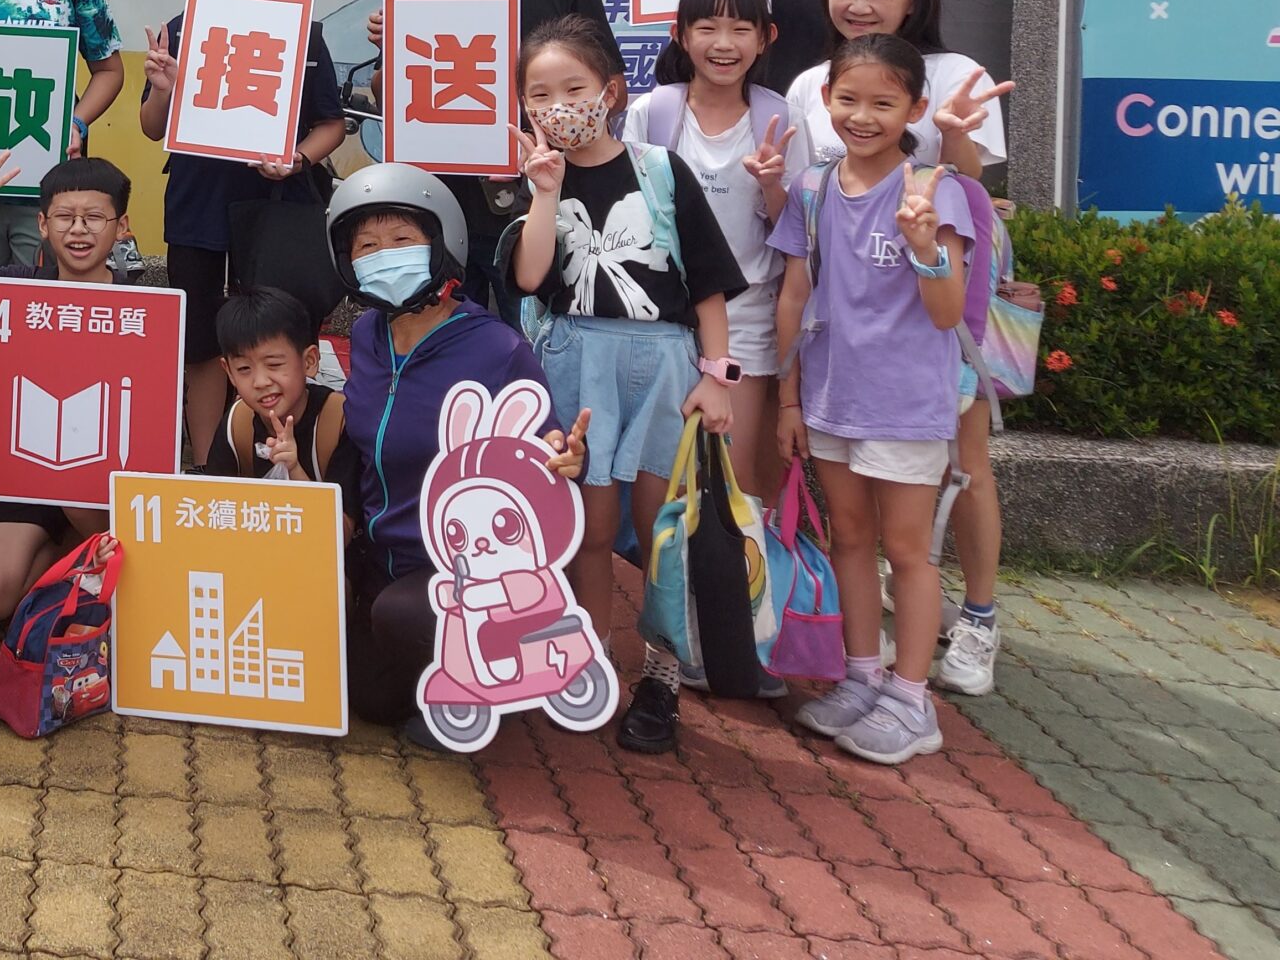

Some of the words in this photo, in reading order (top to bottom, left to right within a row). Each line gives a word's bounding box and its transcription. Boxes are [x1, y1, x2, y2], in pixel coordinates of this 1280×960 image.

[192, 25, 287, 118] 接
[405, 33, 498, 126] 送
[870, 232, 902, 268] LA
[25, 301, 148, 338] 教育品質
[130, 494, 162, 543] 11
[175, 496, 304, 536] 永續城市
